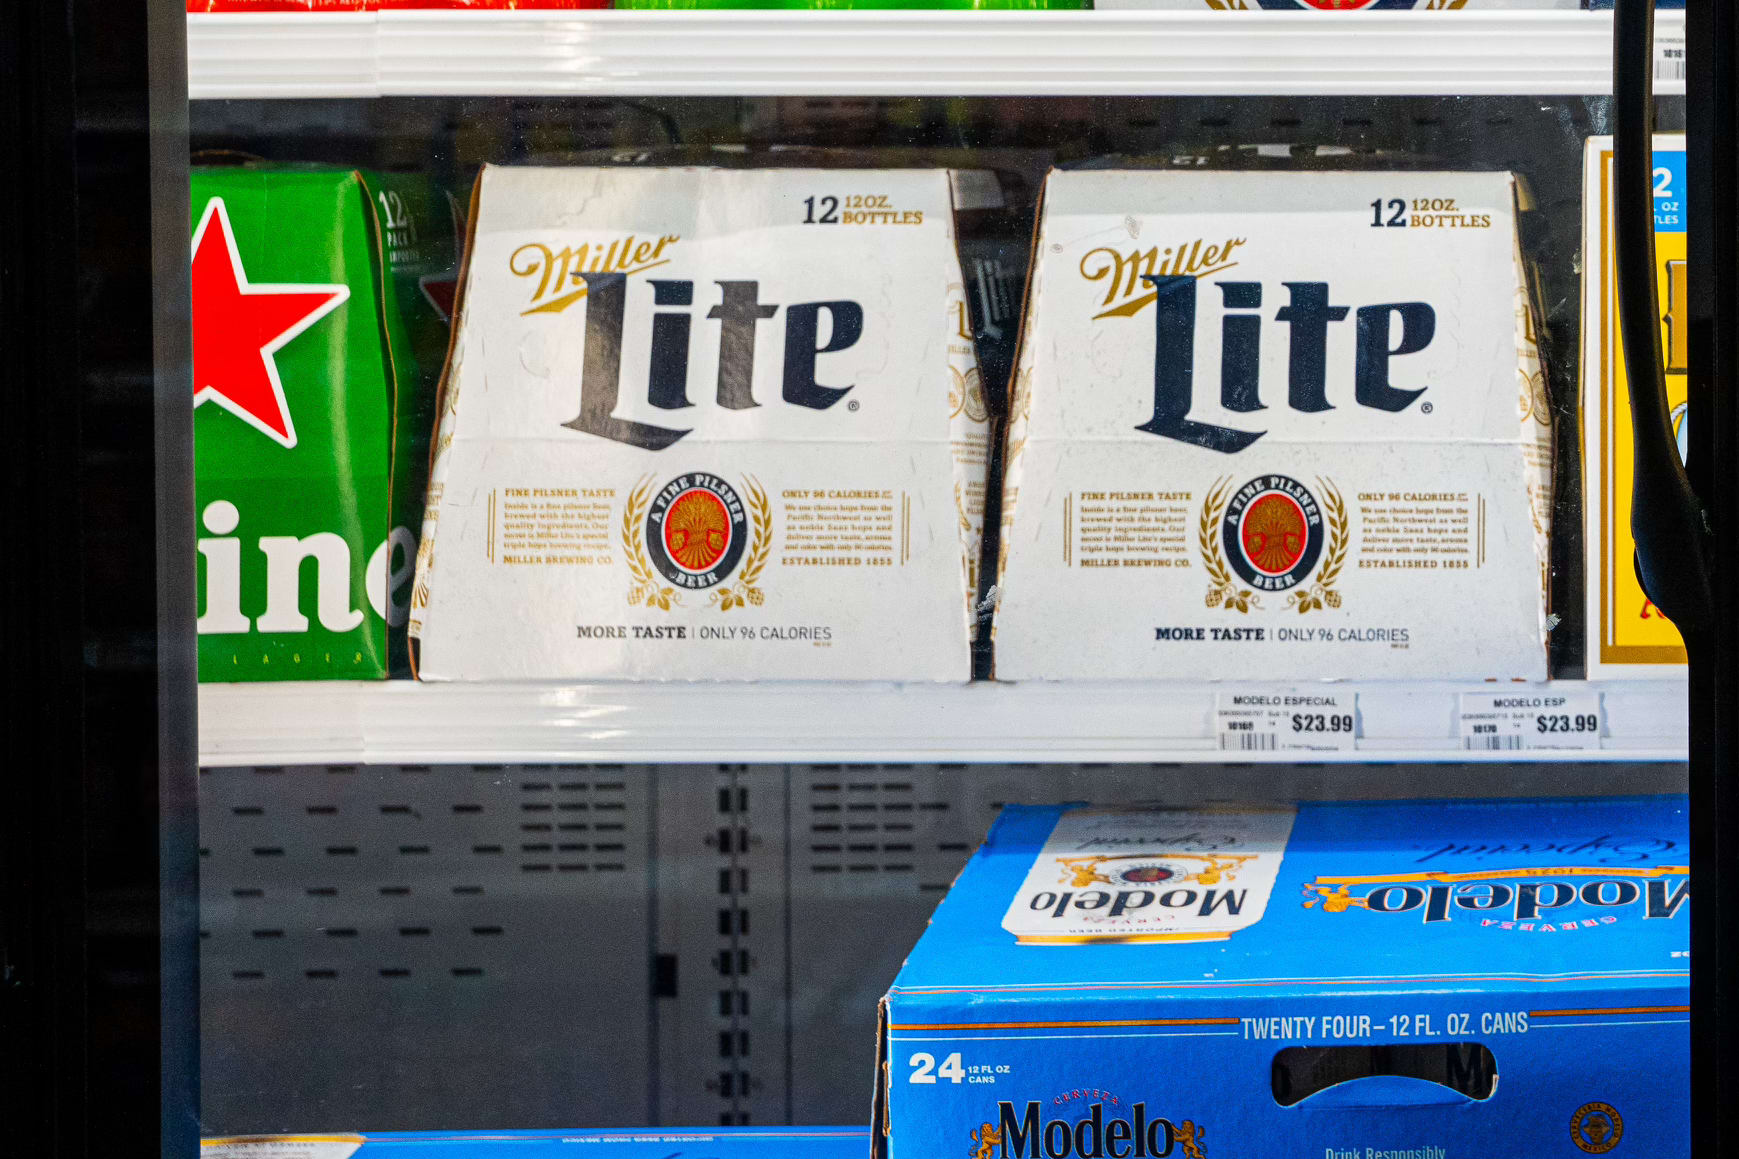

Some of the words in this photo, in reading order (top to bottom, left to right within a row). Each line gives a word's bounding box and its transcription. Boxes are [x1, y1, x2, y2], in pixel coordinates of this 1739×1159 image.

[802, 196, 838, 225] 12
[842, 210, 923, 225] BOTTLES
[1370, 198, 1406, 227] 12
[1410, 214, 1490, 228] BOTTLES
[509, 234, 681, 315] Miller
[1080, 237, 1246, 319] Miller
[560, 271, 864, 451] Lite
[1134, 274, 1436, 454] Lite
[505, 488, 530, 498] FINE
[533, 488, 578, 498] PILSNER
[581, 488, 616, 498] TASTE
[675, 570, 719, 587] BEER
[577, 626, 627, 639] MORE
[632, 626, 687, 639] TASTE
[700, 626, 737, 640] ONLY
[740, 626, 756, 640] 96
[759, 626, 832, 641] CALORIES
[1155, 627, 1206, 641] MORE
[1210, 627, 1265, 641] TASTE
[1278, 627, 1315, 641] ONLY
[1318, 628, 1334, 641] 96
[1337, 628, 1410, 641] CALORIES
[1234, 696, 1281, 706] MODELO
[1285, 696, 1337, 706] ESPECIAL
[1493, 698, 1541, 708] MODELO
[1544, 698, 1565, 707] ESP
[1292, 715, 1353, 732] $23.99
[1537, 715, 1598, 733] $23.99
[1242, 1018, 1315, 1039] TWENTY
[1447, 1014, 1475, 1034] OZ.
[1481, 1013, 1527, 1034] CANS
[909, 1053, 964, 1084] 24
[968, 1066, 979, 1074] 12
[982, 1066, 994, 1074] FL
[996, 1065, 1010, 1073] OZ
[968, 1075, 994, 1083] CANS
[998, 1101, 1175, 1159] Modelo
